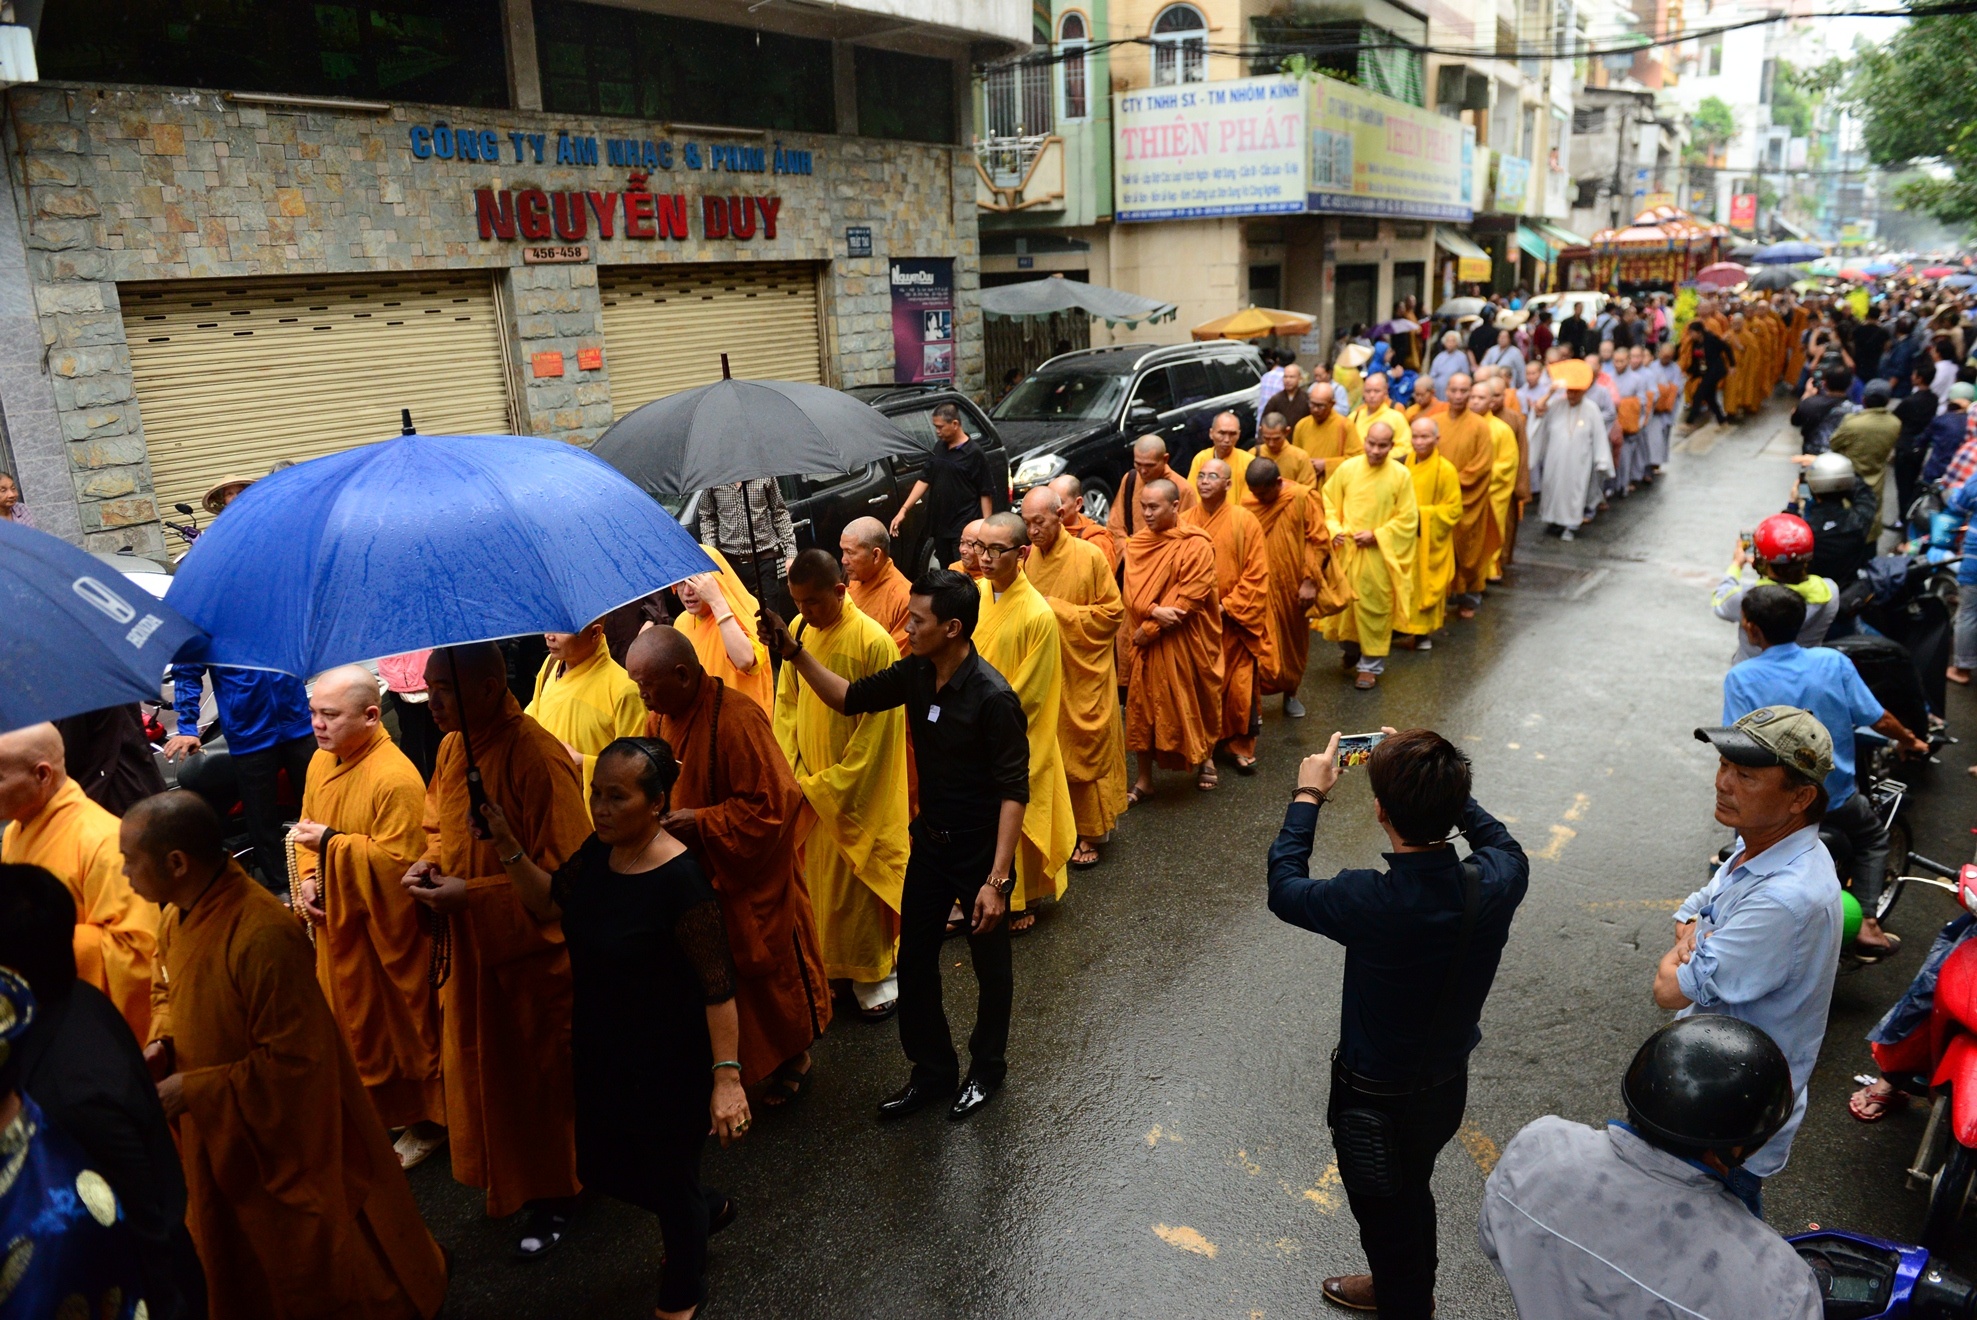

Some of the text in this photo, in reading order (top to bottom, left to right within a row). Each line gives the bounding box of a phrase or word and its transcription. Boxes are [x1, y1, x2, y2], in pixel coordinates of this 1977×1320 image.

[1121, 96, 1142, 113] CTY
[1147, 94, 1178, 110] TNHH
[1182, 91, 1196, 107] SX
[1208, 89, 1226, 105] TM
[1230, 82, 1266, 102] NHÔM
[410, 120, 813, 175] CÔNG TY ÂM NHẠC & PHIM ẢNH
[1120, 113, 1210, 165] THIỆN
[1218, 105, 1301, 153] PHÁT
[473, 172, 782, 242] NGUYỄN DUY
[532, 247, 582, 260] 456-458
[125, 613, 164, 649] HONDA
